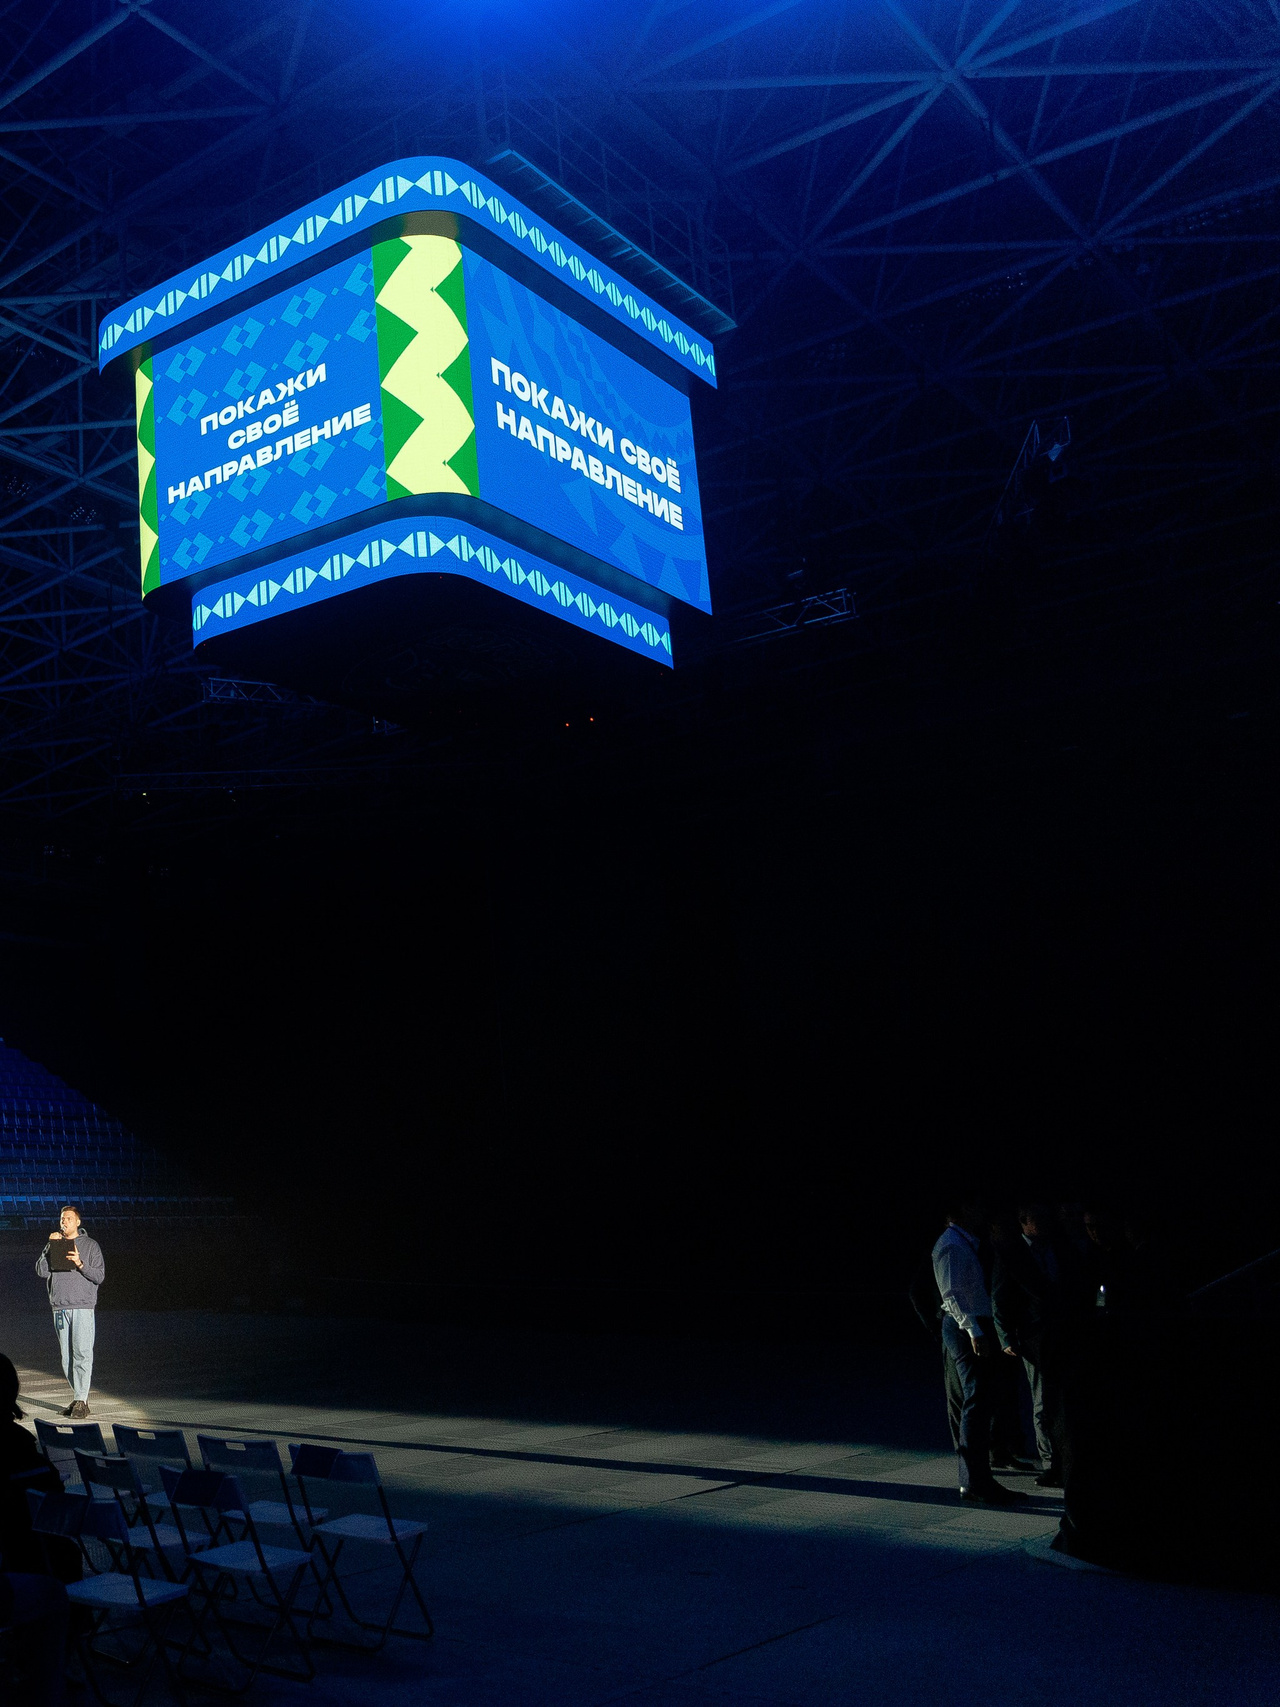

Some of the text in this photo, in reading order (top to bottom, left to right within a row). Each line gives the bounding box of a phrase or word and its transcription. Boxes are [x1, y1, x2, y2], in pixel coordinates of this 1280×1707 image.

[200, 362, 327, 436] ПОКАЖИ
[227, 399, 300, 450] СВОЁ
[490, 356, 682, 494] ПОКАЖИ СВОЁ
[167, 402, 372, 505] НАПРАВЛЕНИЕ
[496, 401, 684, 531] НАПРАВЛЕНИЕ
